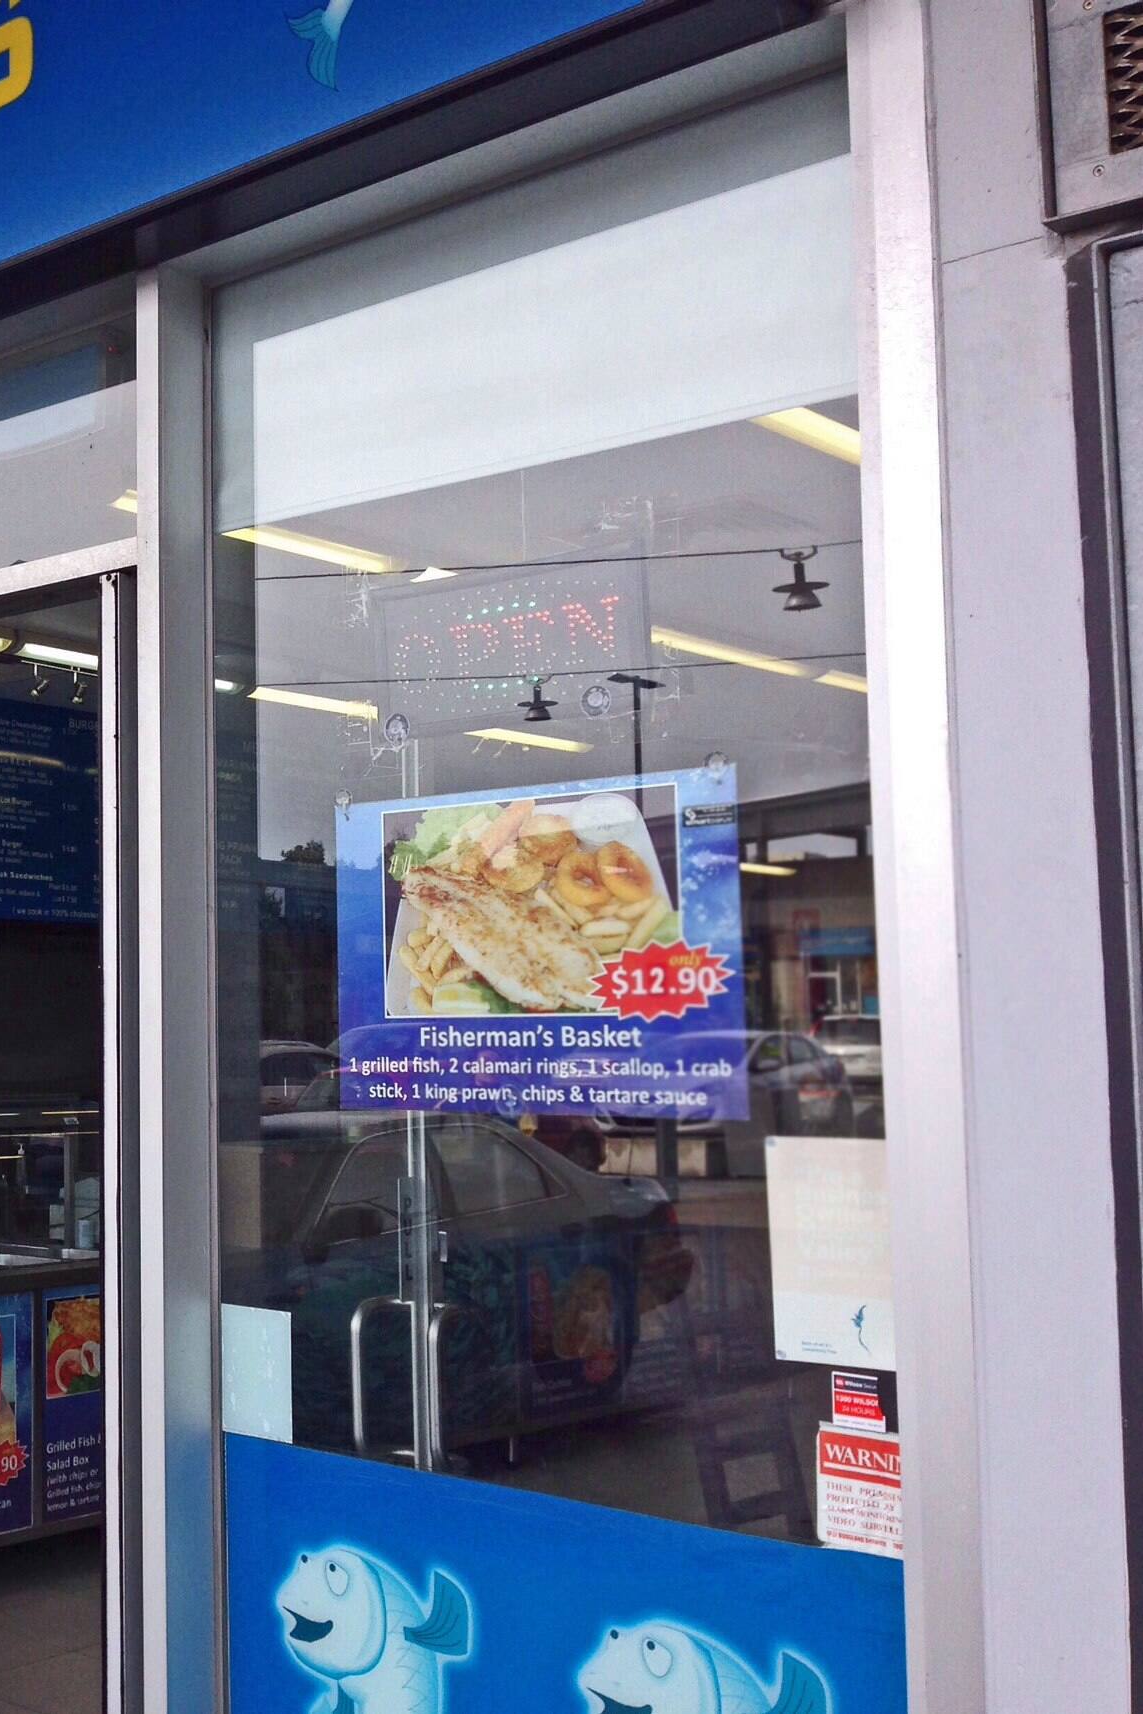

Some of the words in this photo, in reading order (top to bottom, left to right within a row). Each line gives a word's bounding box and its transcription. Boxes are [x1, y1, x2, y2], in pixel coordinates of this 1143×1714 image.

[394, 596, 619, 694] OPEN
[668, 951, 701, 969] only
[611, 965, 717, 999] $12.90
[420, 1025, 555, 1048] Fisherman's
[560, 1024, 642, 1048] Basket
[349, 1057, 358, 1073] 1
[361, 1057, 408, 1076] grilled
[413, 1057, 445, 1075] fish,
[449, 1058, 458, 1073] 2
[462, 1058, 532, 1074] calamari
[537, 1058, 582, 1079] rings,
[588, 1060, 597, 1075] 1
[602, 1058, 671, 1080] scallop,
[676, 1060, 685, 1076] 1
[691, 1059, 733, 1077] crab
[369, 1083, 408, 1101] stick,
[412, 1083, 420, 1098] 1
[425, 1083, 458, 1103] king
[522, 1084, 565, 1105] chips
[569, 1085, 585, 1103] &
[588, 1087, 652, 1104] tartare
[654, 1091, 708, 1106] sauce
[46, 1438, 76, 1454] Grilled
[78, 1434, 96, 1449] Fish
[46, 1456, 71, 1472] Salad
[73, 1456, 90, 1467] Box
